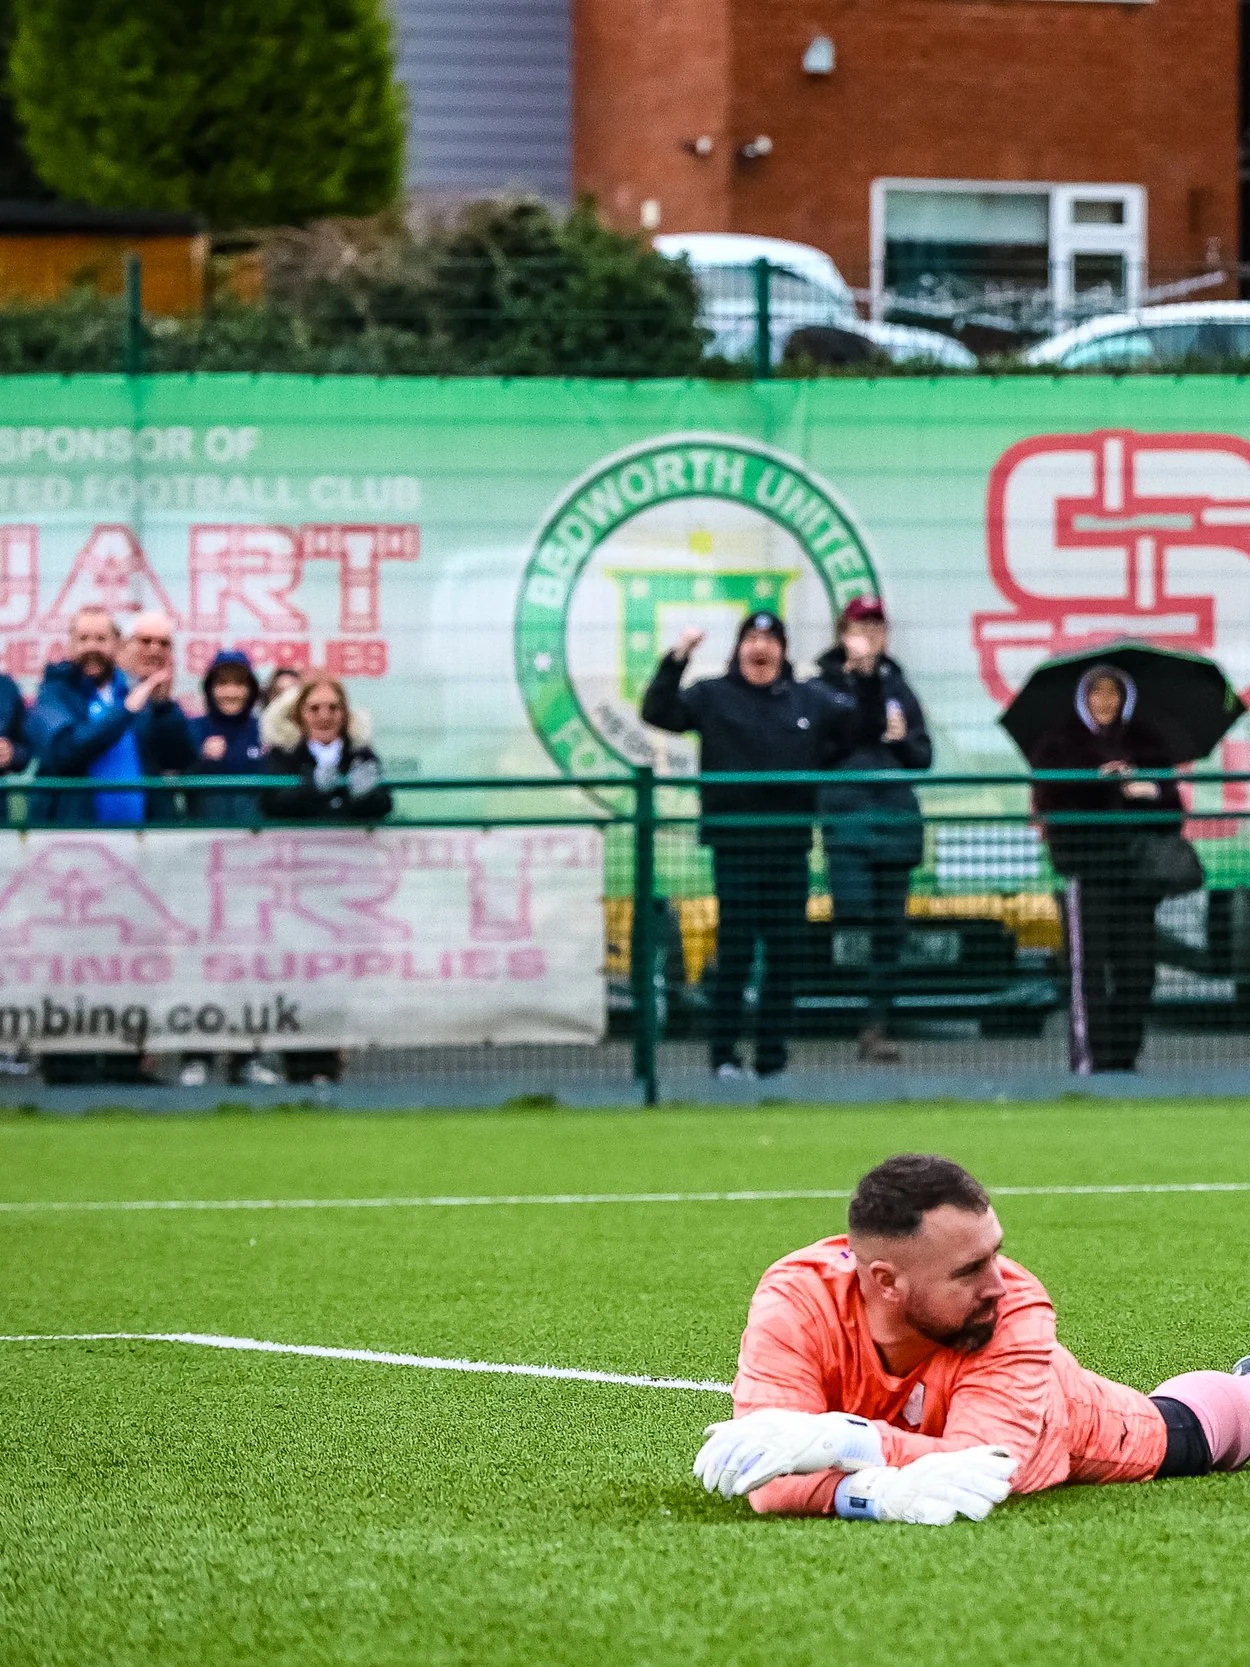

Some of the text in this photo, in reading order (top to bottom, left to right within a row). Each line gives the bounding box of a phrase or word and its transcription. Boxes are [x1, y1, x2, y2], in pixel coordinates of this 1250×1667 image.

[0, 426, 259, 462] SPONSOR OF
[83, 476, 298, 511] FOOTBALL
[309, 476, 422, 510] CLUB
[525, 448, 874, 611] BEDWORTH UNITED
[202, 948, 546, 984] SUPPLIES
